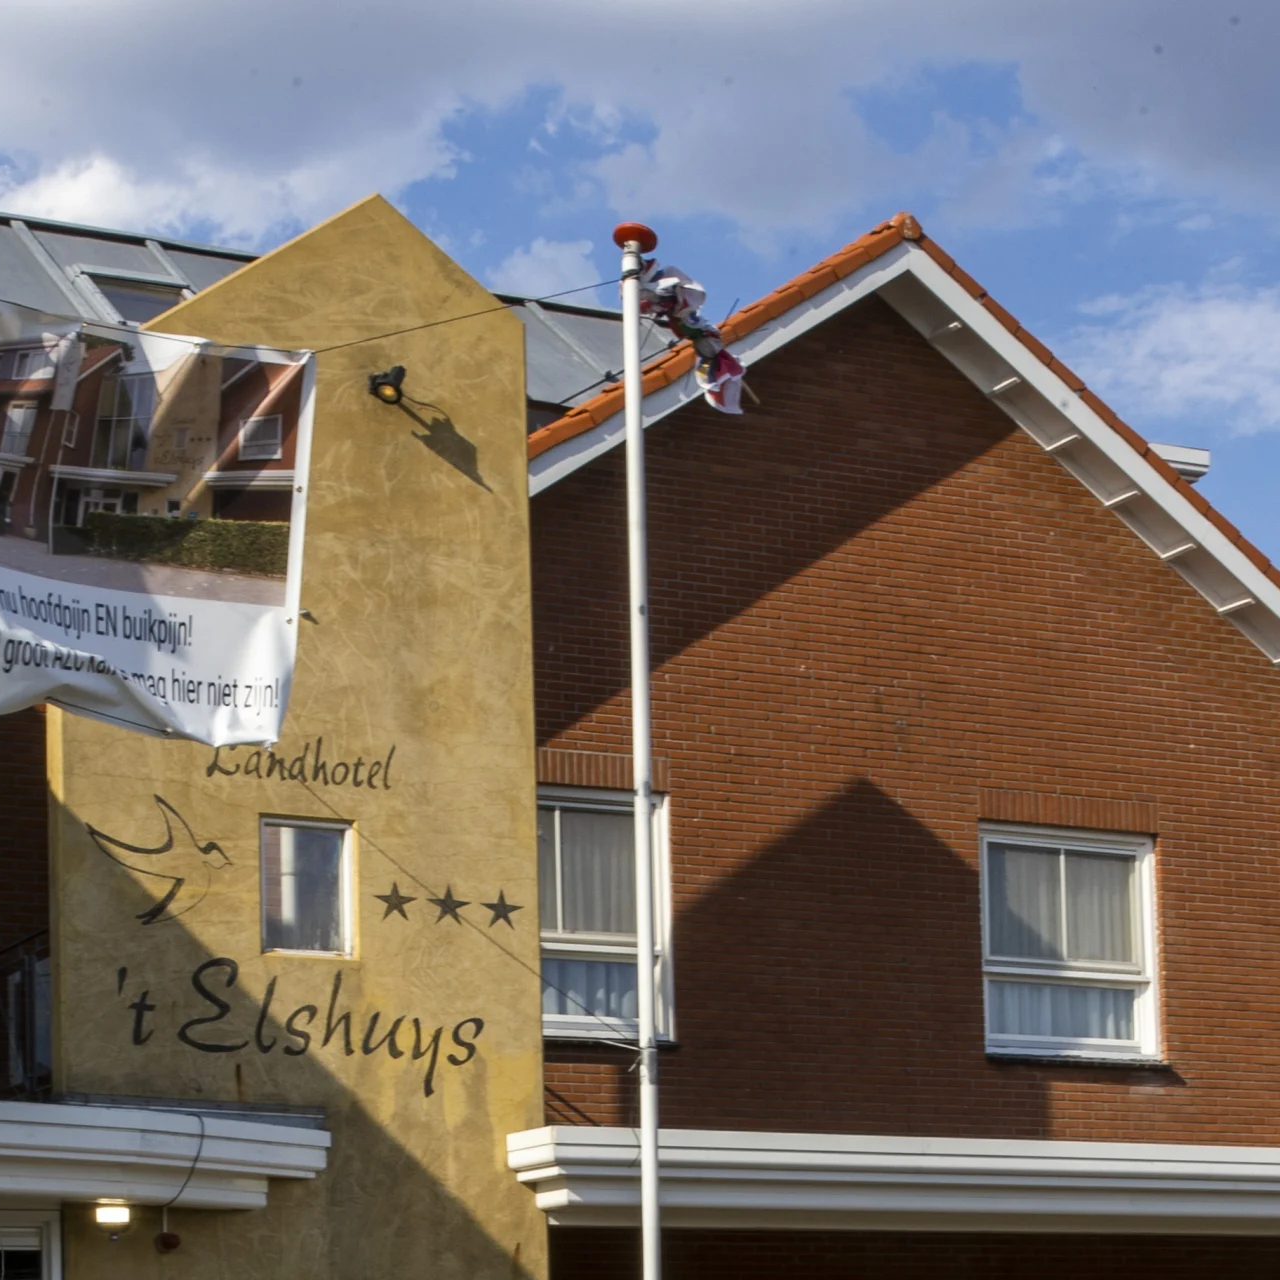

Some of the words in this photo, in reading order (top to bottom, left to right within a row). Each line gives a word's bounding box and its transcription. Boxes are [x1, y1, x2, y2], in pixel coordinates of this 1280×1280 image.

[19, 585, 91, 639] hoofdpijn
[95, 603, 118, 637] EN
[123, 605, 193, 653] buikpijn!
[2, 638, 48, 673] groot
[131, 672, 168, 705] mag
[172, 667, 203, 703] hier
[207, 675, 239, 708] niet
[244, 677, 280, 716] zijn!
[206, 736, 396, 790] Landhotel
[116, 967, 156, 1046] 't
[177, 957, 485, 1098] Elshuys
